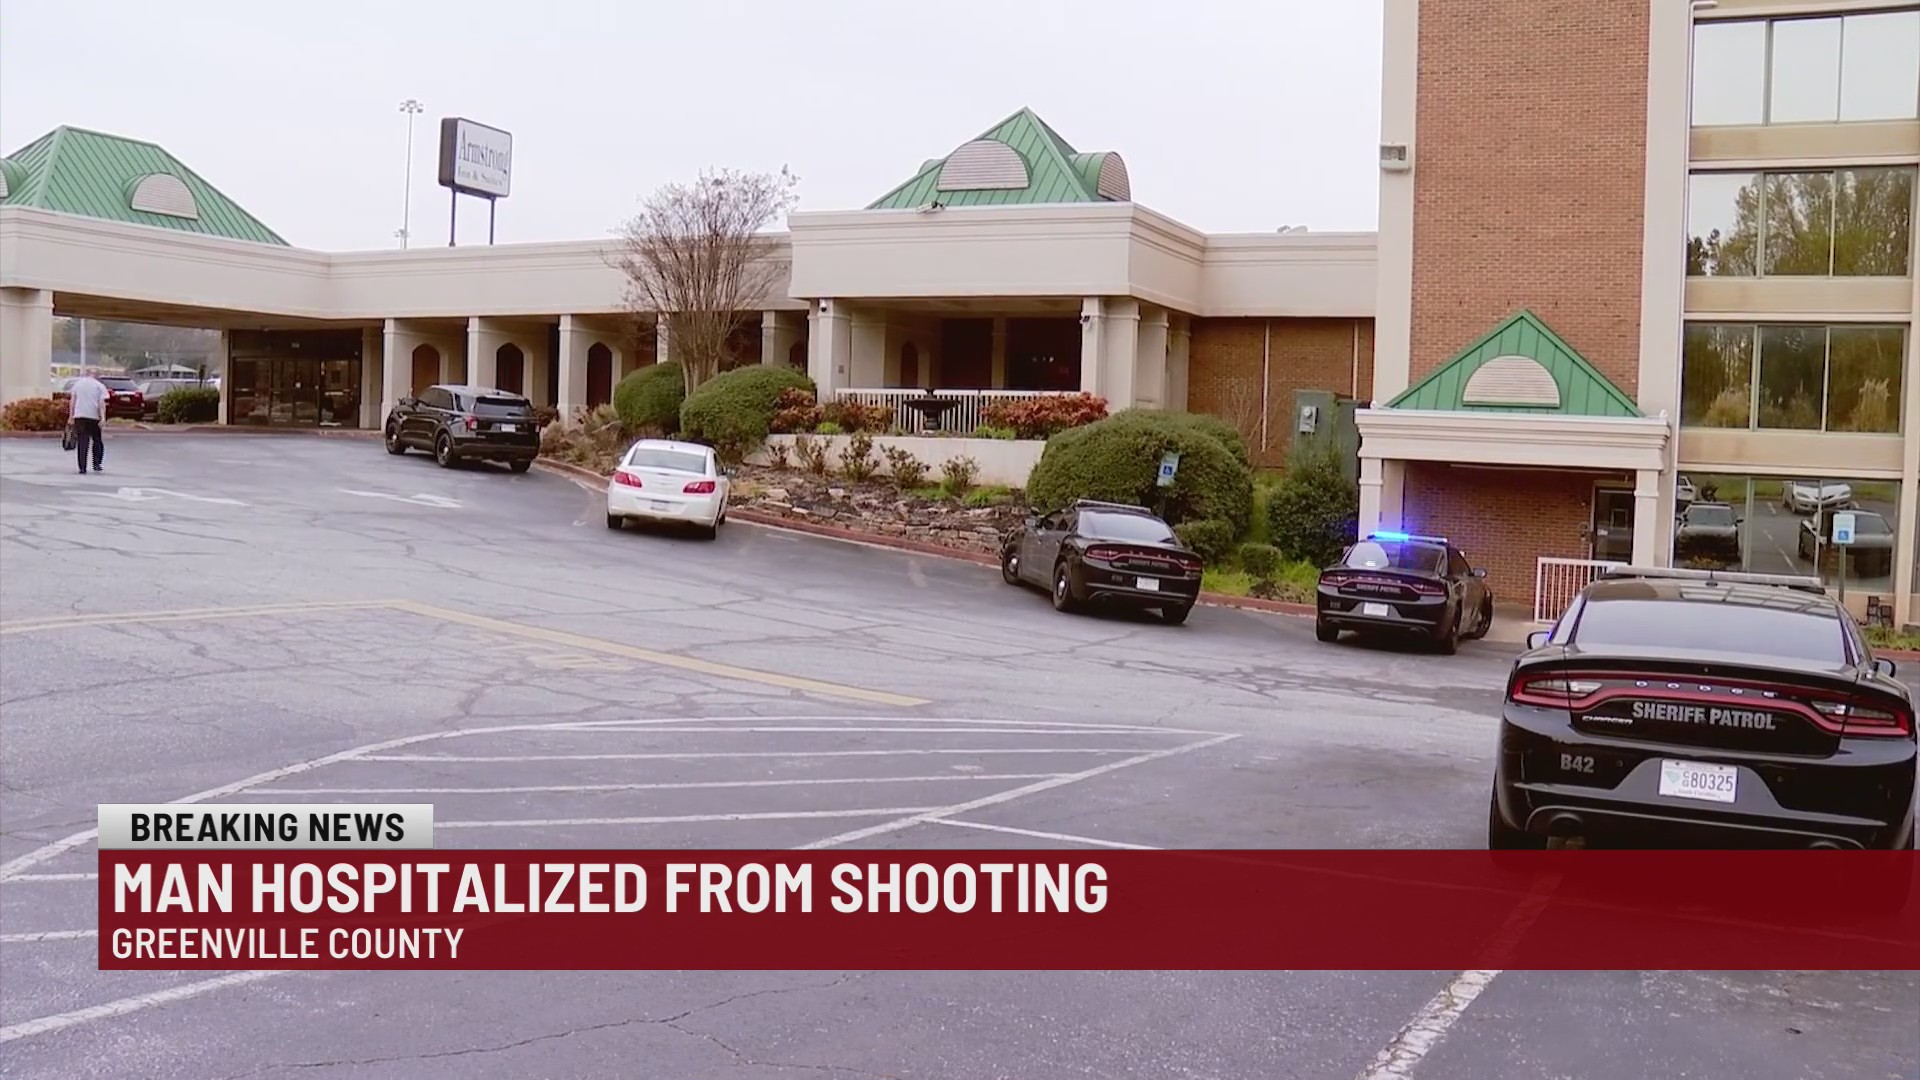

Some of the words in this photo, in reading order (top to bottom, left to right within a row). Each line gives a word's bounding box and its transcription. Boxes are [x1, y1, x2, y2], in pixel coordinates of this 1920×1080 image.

[458, 129, 508, 175] Armstrong
[1632, 701, 1705, 724] SHERIFF
[1709, 708, 1776, 730] PATROL
[1561, 753, 1594, 773] B42
[1691, 772, 1733, 792] 80325
